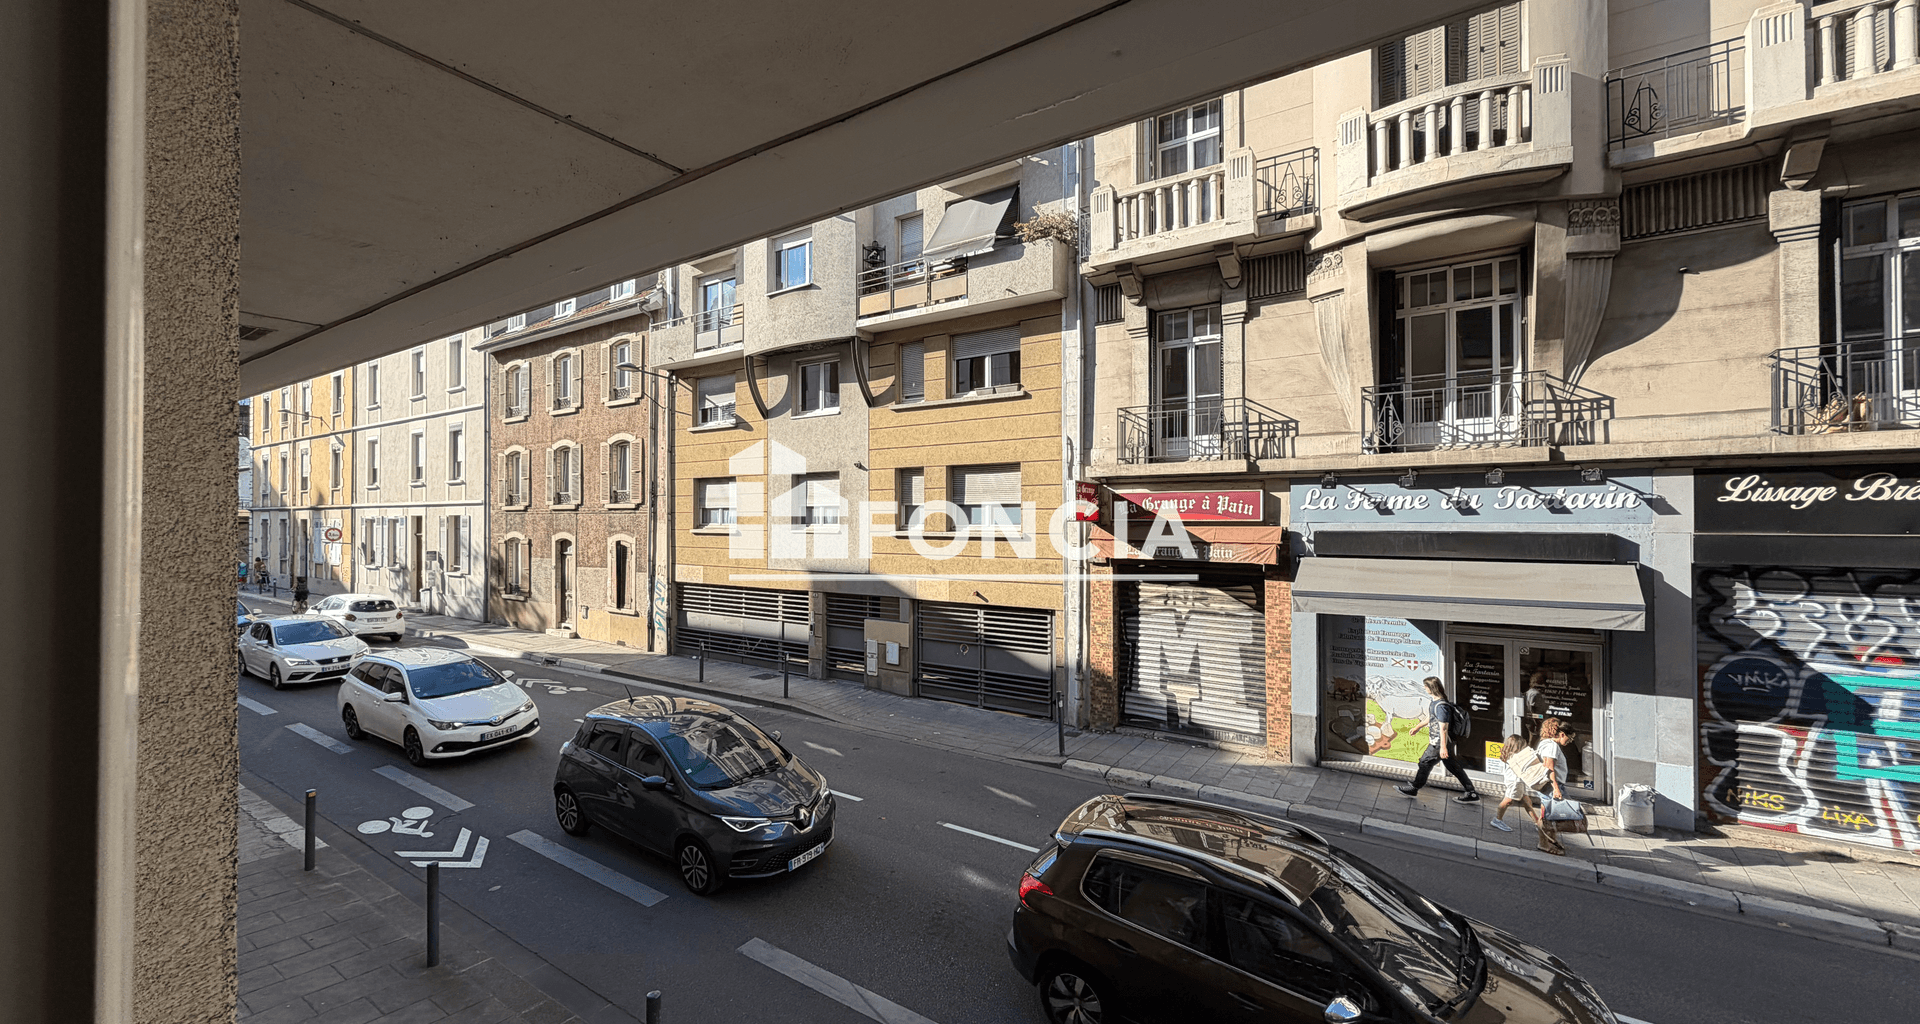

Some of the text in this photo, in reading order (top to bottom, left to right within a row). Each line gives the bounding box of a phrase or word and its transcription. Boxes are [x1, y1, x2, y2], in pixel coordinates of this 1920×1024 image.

[1300, 485, 1642, 511] La Ferme du Tartarin
[1717, 474, 1837, 510] Lissage
[1141, 496, 1196, 514] Grange
[1201, 495, 1211, 510] à
[1217, 494, 1254, 516] Pain
[1144, 544, 1188, 560] Grange
[1203, 544, 1234, 560] Pain
